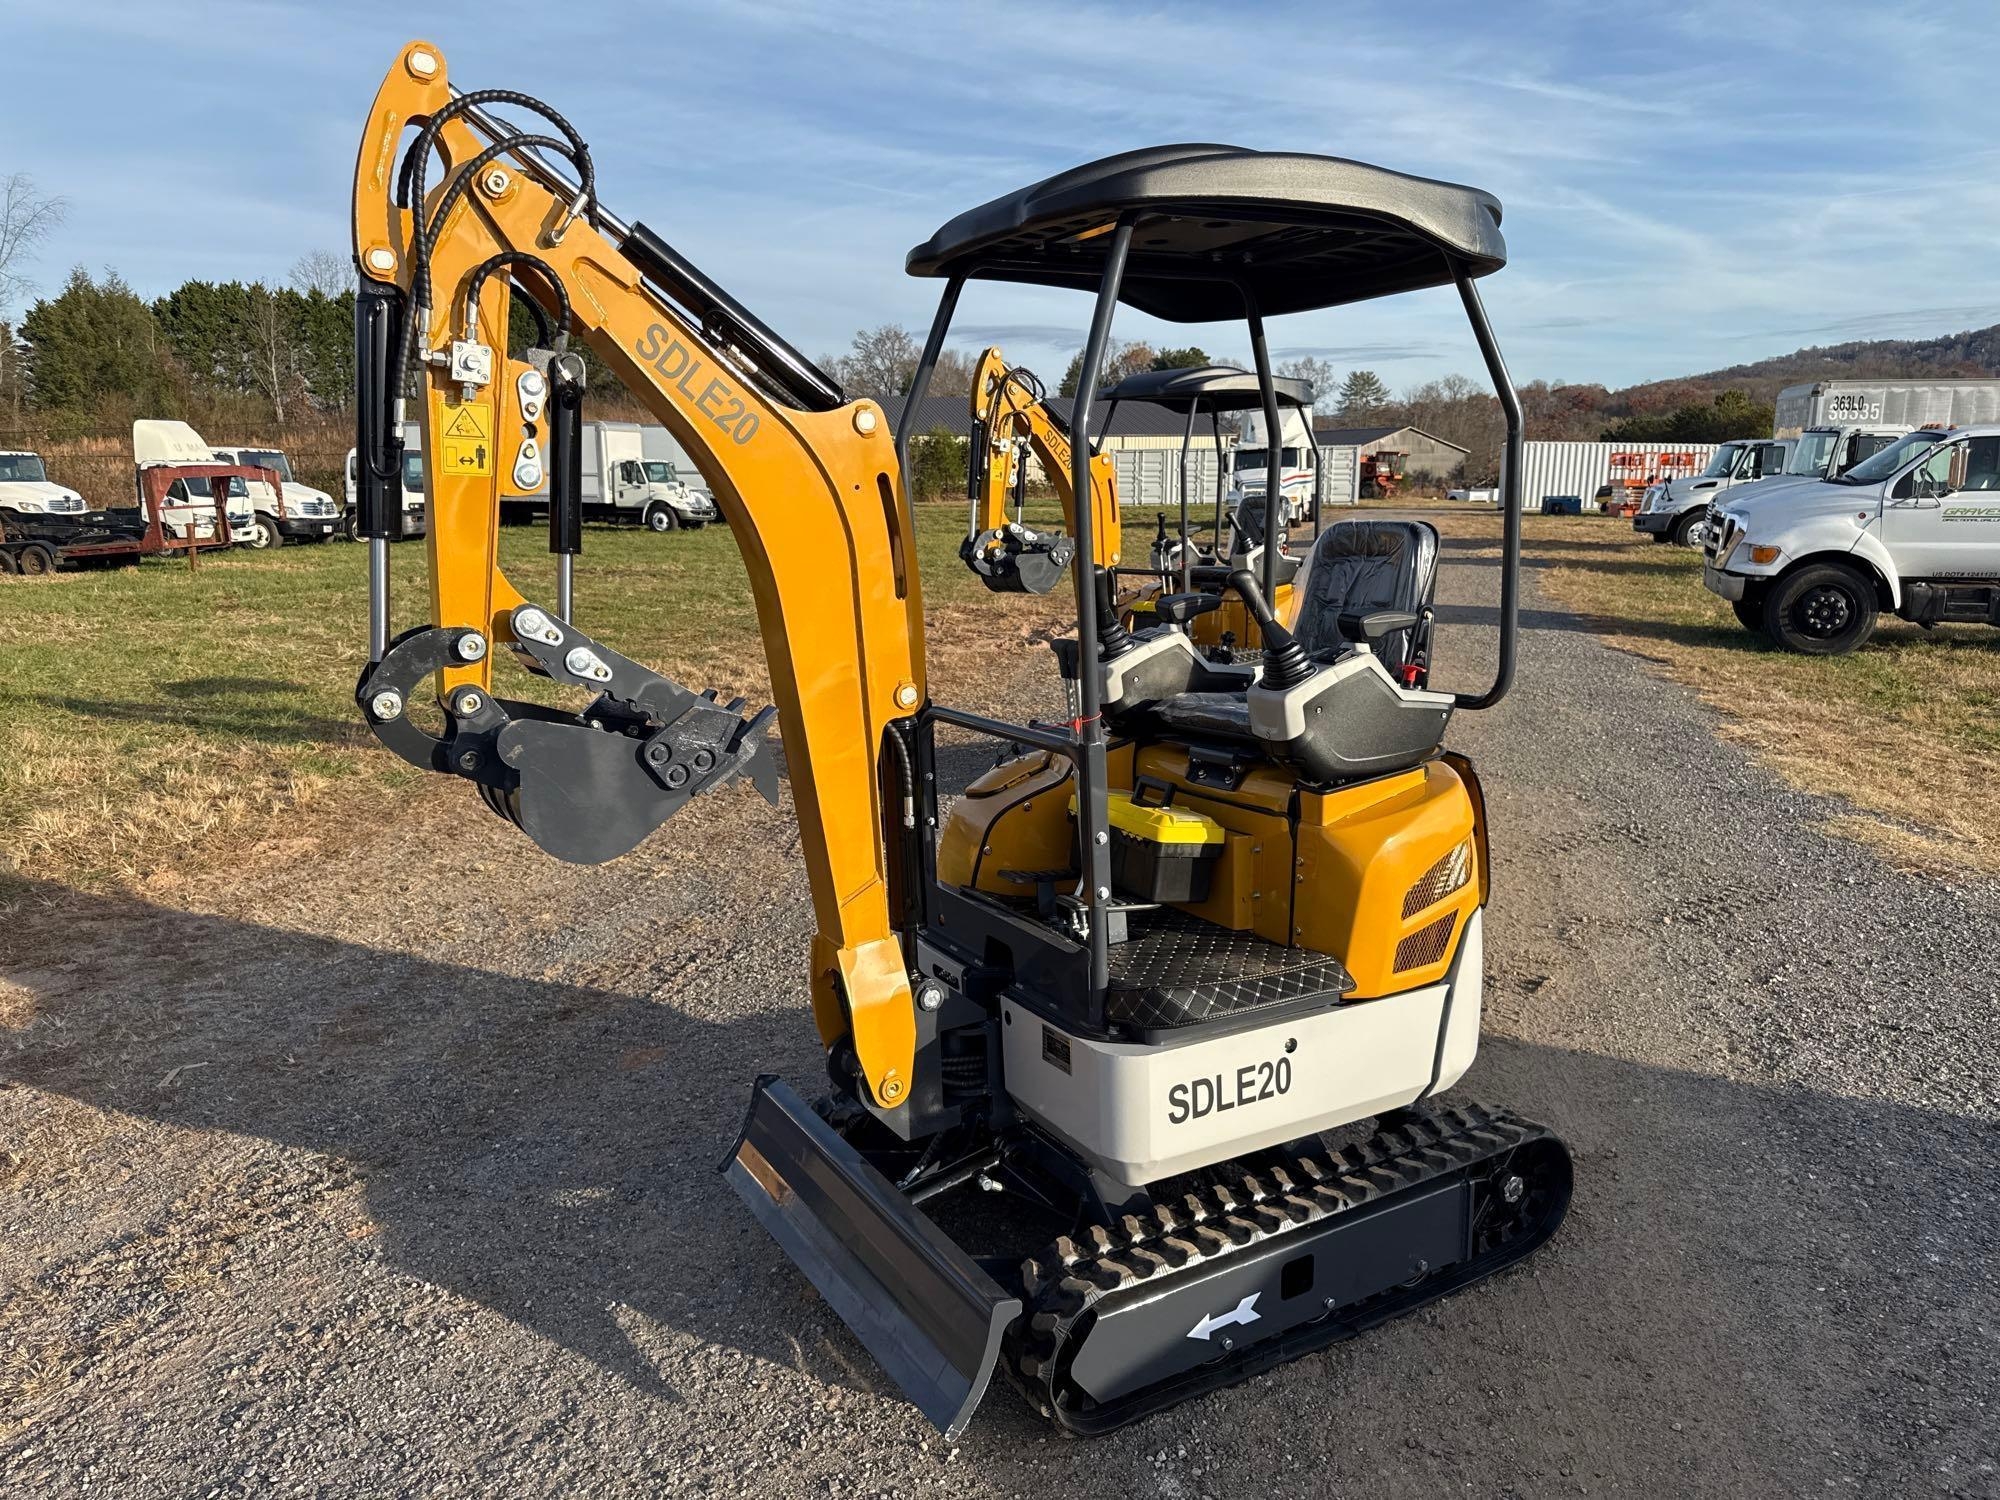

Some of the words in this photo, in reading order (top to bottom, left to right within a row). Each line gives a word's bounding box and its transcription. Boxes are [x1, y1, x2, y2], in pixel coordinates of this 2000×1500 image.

[635, 323, 760, 445] SDLE20
[1942, 507, 2000, 516] GRAVE
[1168, 1056, 1292, 1125] SDLE20
